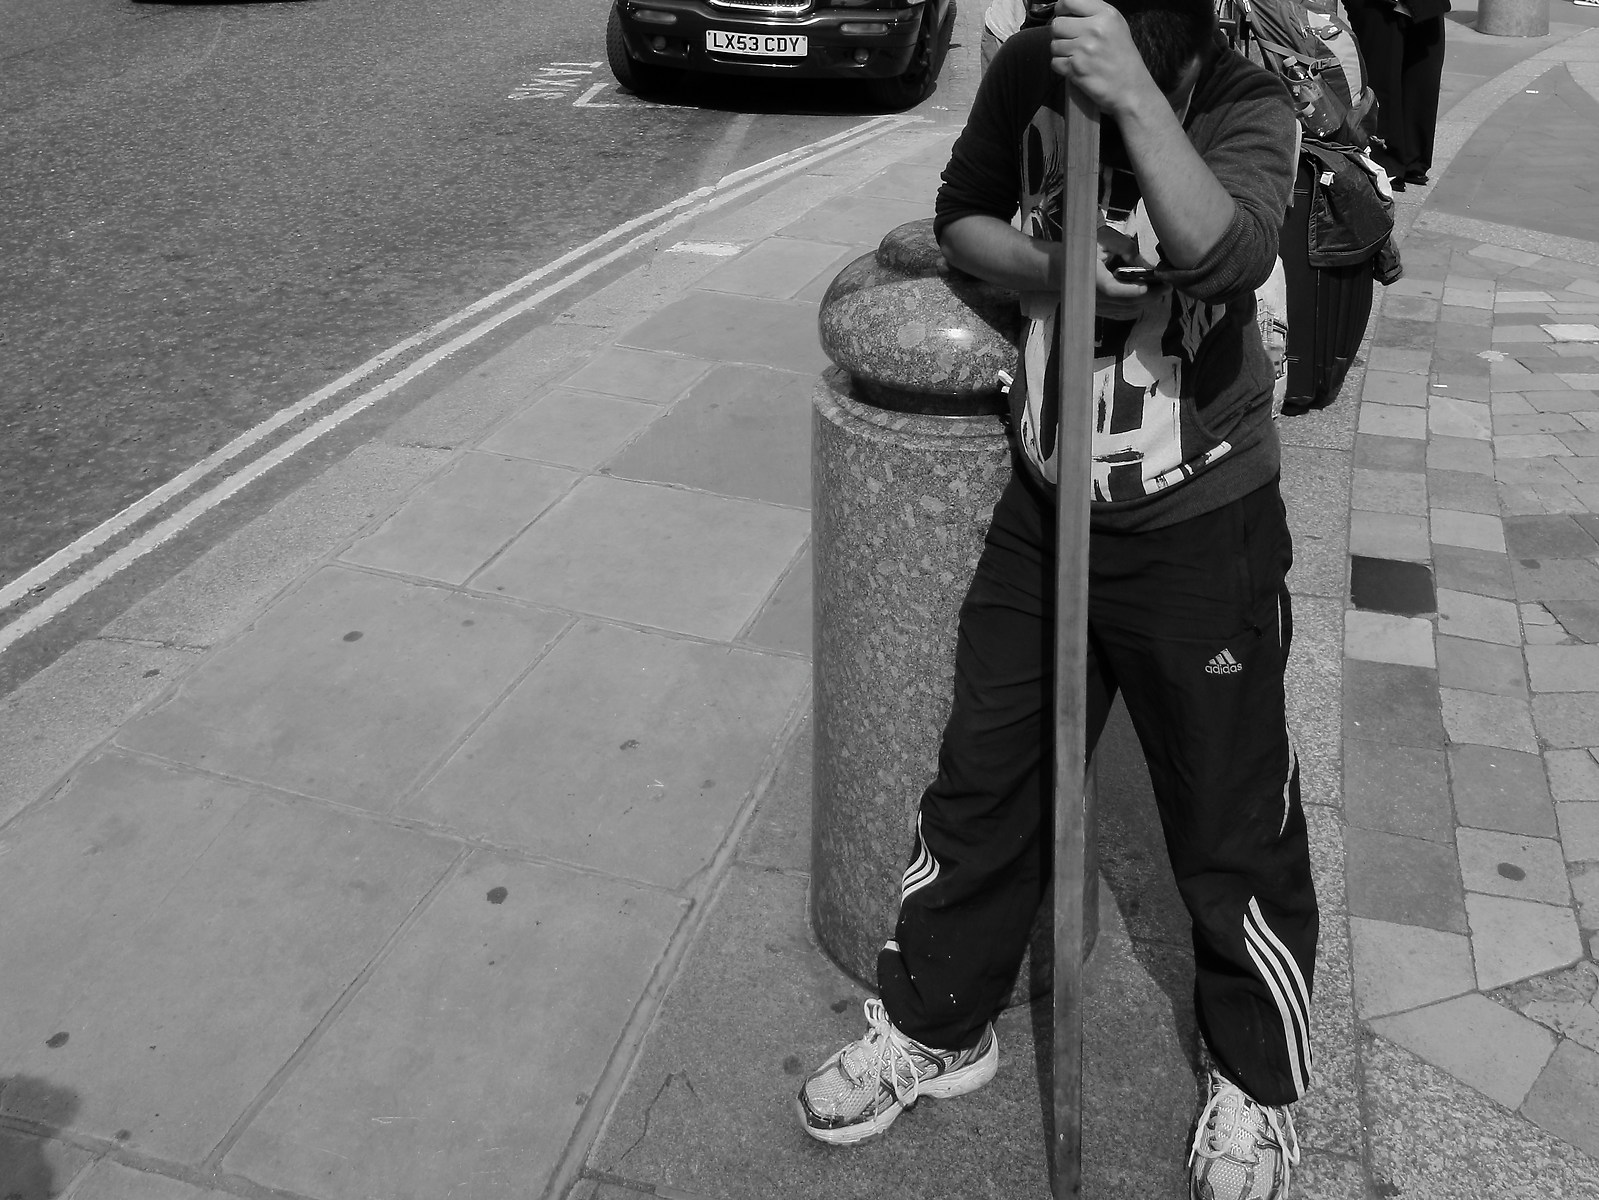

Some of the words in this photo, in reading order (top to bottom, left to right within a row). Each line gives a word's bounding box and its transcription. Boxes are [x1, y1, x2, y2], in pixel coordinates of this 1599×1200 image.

[713, 32, 759, 52] LX53
[764, 37, 800, 53] CDY
[1204, 663, 1243, 675] adidas
